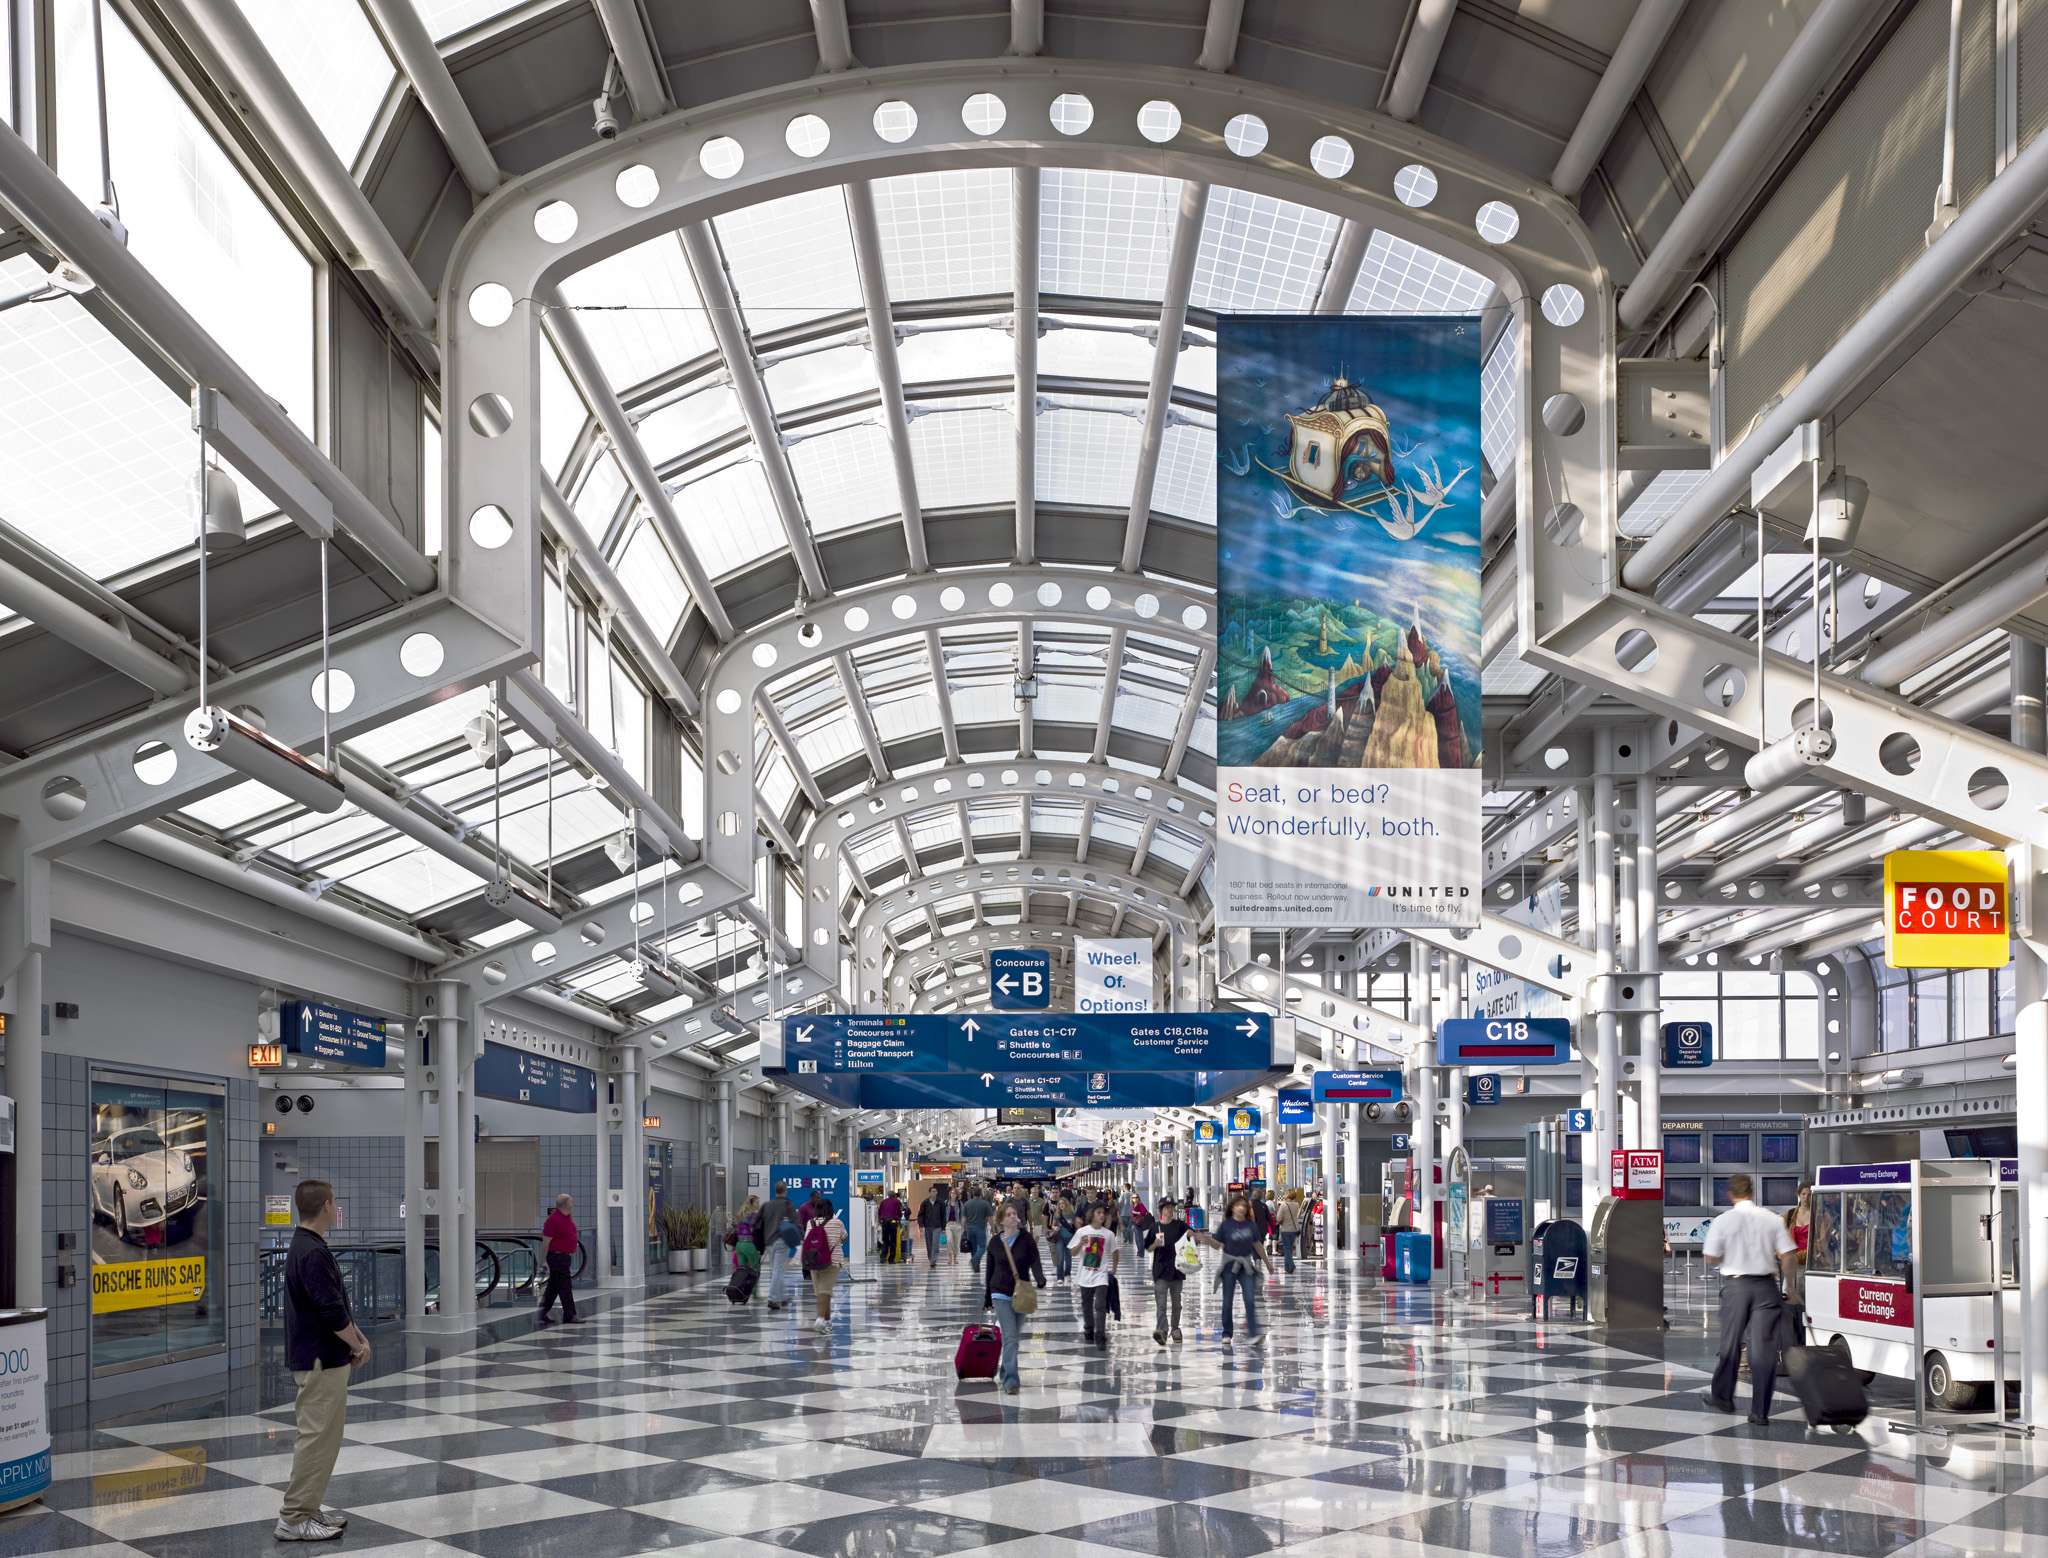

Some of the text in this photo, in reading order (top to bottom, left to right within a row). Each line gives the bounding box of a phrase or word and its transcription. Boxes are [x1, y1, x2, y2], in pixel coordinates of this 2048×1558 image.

[1228, 783, 1389, 805] Seat, or bed?
[1228, 816, 1439, 840] Wonderfully, both.
[1304, 881, 1348, 890] international
[1388, 886, 1470, 897] UNITED
[1902, 888, 1996, 910] FOOD
[1230, 904, 1333, 912] suitedreams.united.com
[1392, 904, 1461, 914] It's time to fly.
[1899, 911, 2000, 928] COURT
[996, 959, 1045, 967] Concourse
[1088, 952, 1141, 965] Wheel.
[1022, 972, 1042, 996] B
[1104, 976, 1126, 988] Of.
[1476, 970, 1492, 994] Spin
[1080, 999, 1148, 1014] Options!
[1487, 992, 1518, 1018] GATE C17
[1010, 1028, 1076, 1036] Gates C1-C17
[1130, 1028, 1208, 1036] Gates C18,C18a
[1486, 1022, 1528, 1040] C18
[848, 1040, 881, 1048] Baggage
[251, 1046, 280, 1063] EXIT
[877, 1050, 914, 1058] Transport
[1574, 1112, 1586, 1130] $
[1396, 1136, 1404, 1148] $
[1632, 1158, 1656, 1166] ATM
[1860, 1170, 1898, 1180] Currency Exchange
[783, 1177, 838, 1189] LIBRTY
[1664, 1222, 1680, 1230] rly?
[93, 1264, 202, 1294] ORSCHE RUNS SAP.
[1859, 1288, 1894, 1303] Currency
[1858, 1301, 1895, 1318] Exchange
